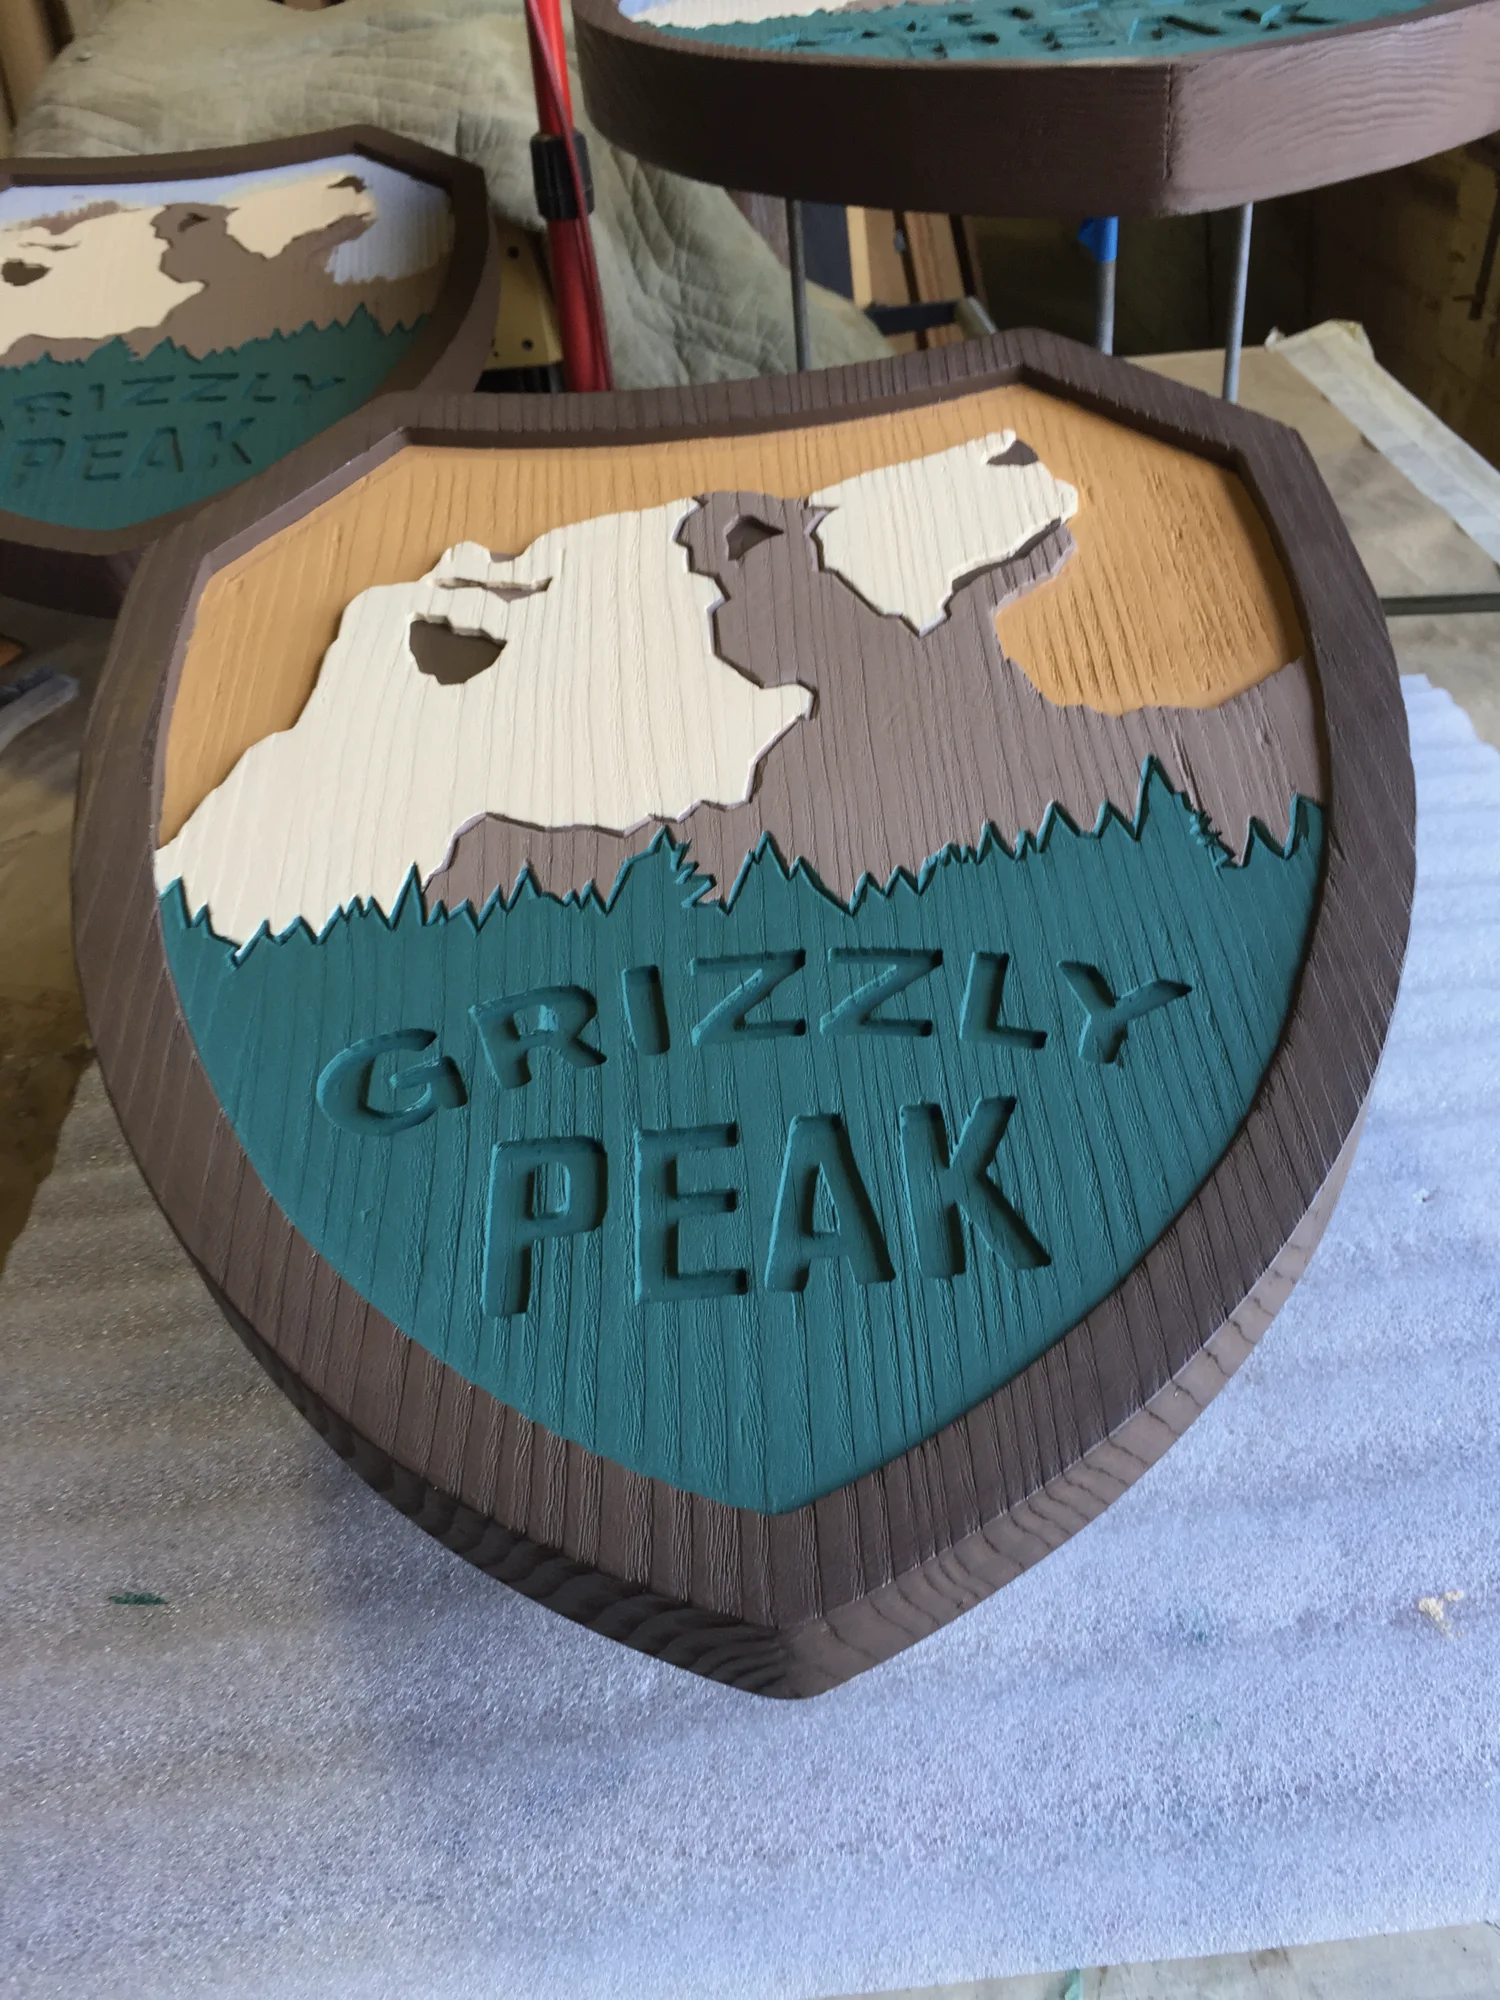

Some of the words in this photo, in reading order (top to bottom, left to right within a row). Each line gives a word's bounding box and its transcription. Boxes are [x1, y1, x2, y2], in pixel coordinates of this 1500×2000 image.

[0, 372, 345, 431] RIZZLY
[4, 416, 256, 490] PEAK
[314, 948, 1192, 1136] GRIZZLY
[481, 1096, 1051, 1316] PEAK
